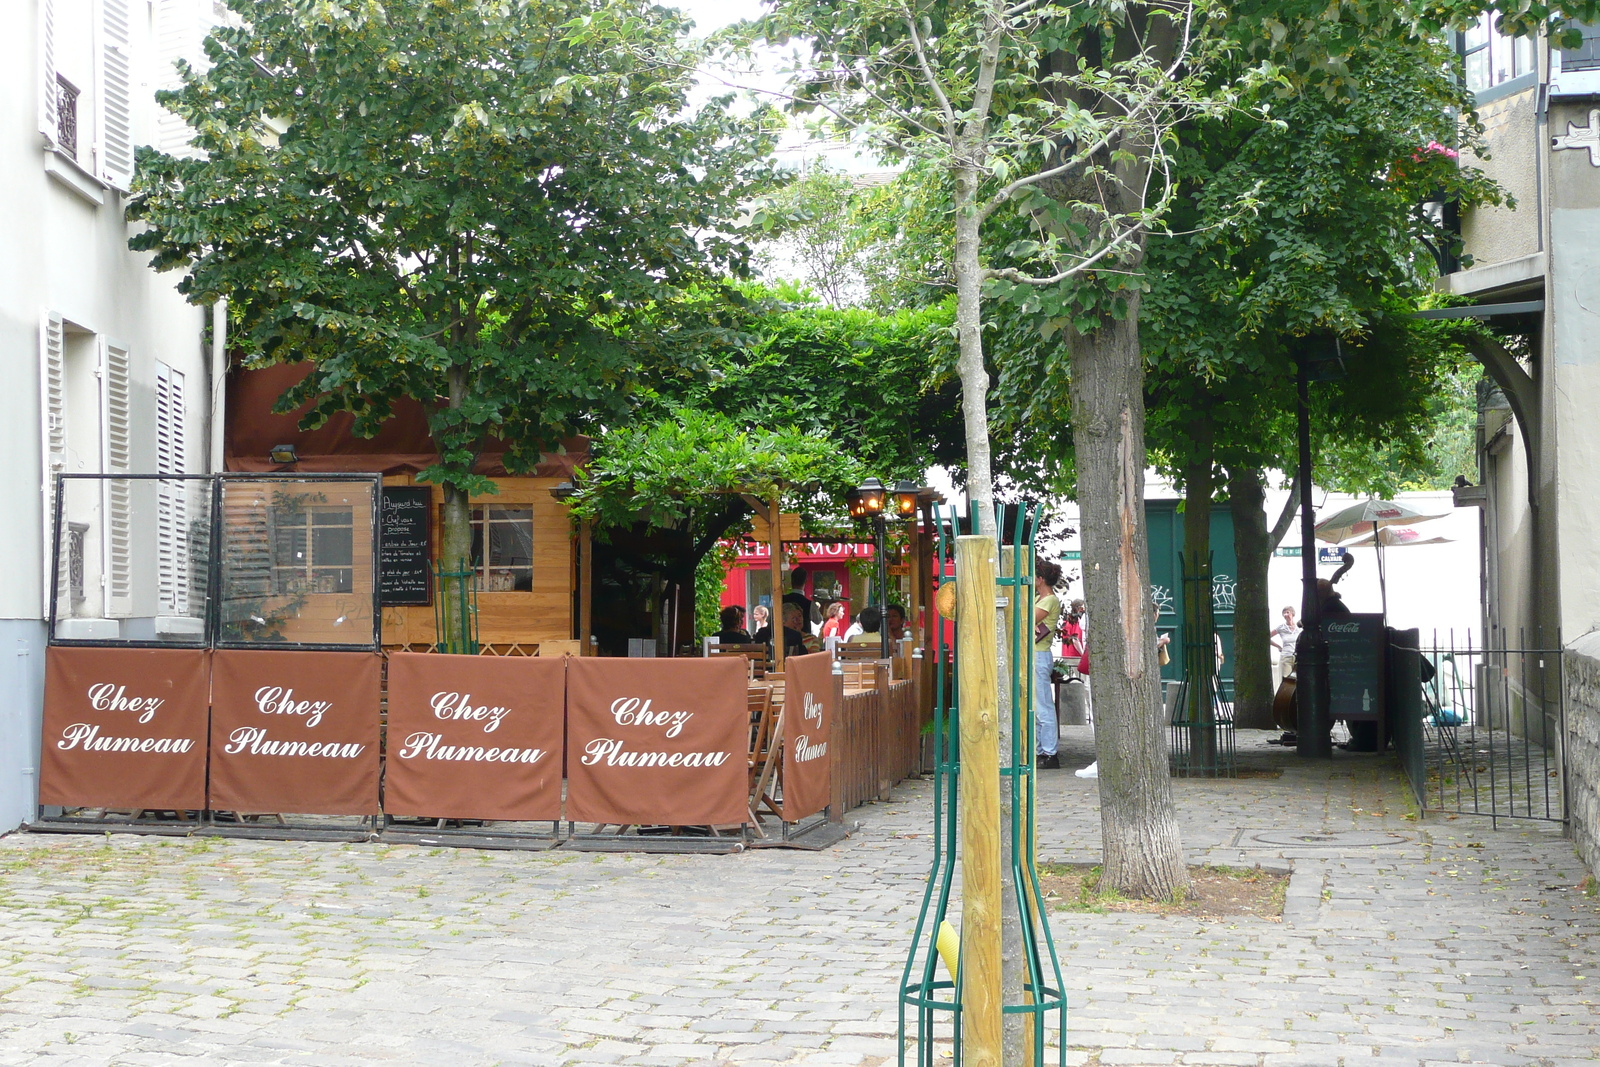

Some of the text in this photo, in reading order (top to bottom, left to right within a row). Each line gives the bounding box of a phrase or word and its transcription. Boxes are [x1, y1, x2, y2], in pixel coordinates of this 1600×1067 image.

[1327, 622, 1360, 633] Coca-Cola
[88, 683, 164, 723] Chez
[255, 686, 332, 727] Chez
[431, 691, 512, 733] Chez
[611, 697, 693, 738] Chez
[804, 692, 823, 730] Chez
[57, 723, 195, 753] Plumeau
[225, 726, 365, 758] Plumeau
[399, 732, 546, 763] Plumeau
[581, 738, 731, 768] Plumeau
[795, 735, 827, 763] Plumea
